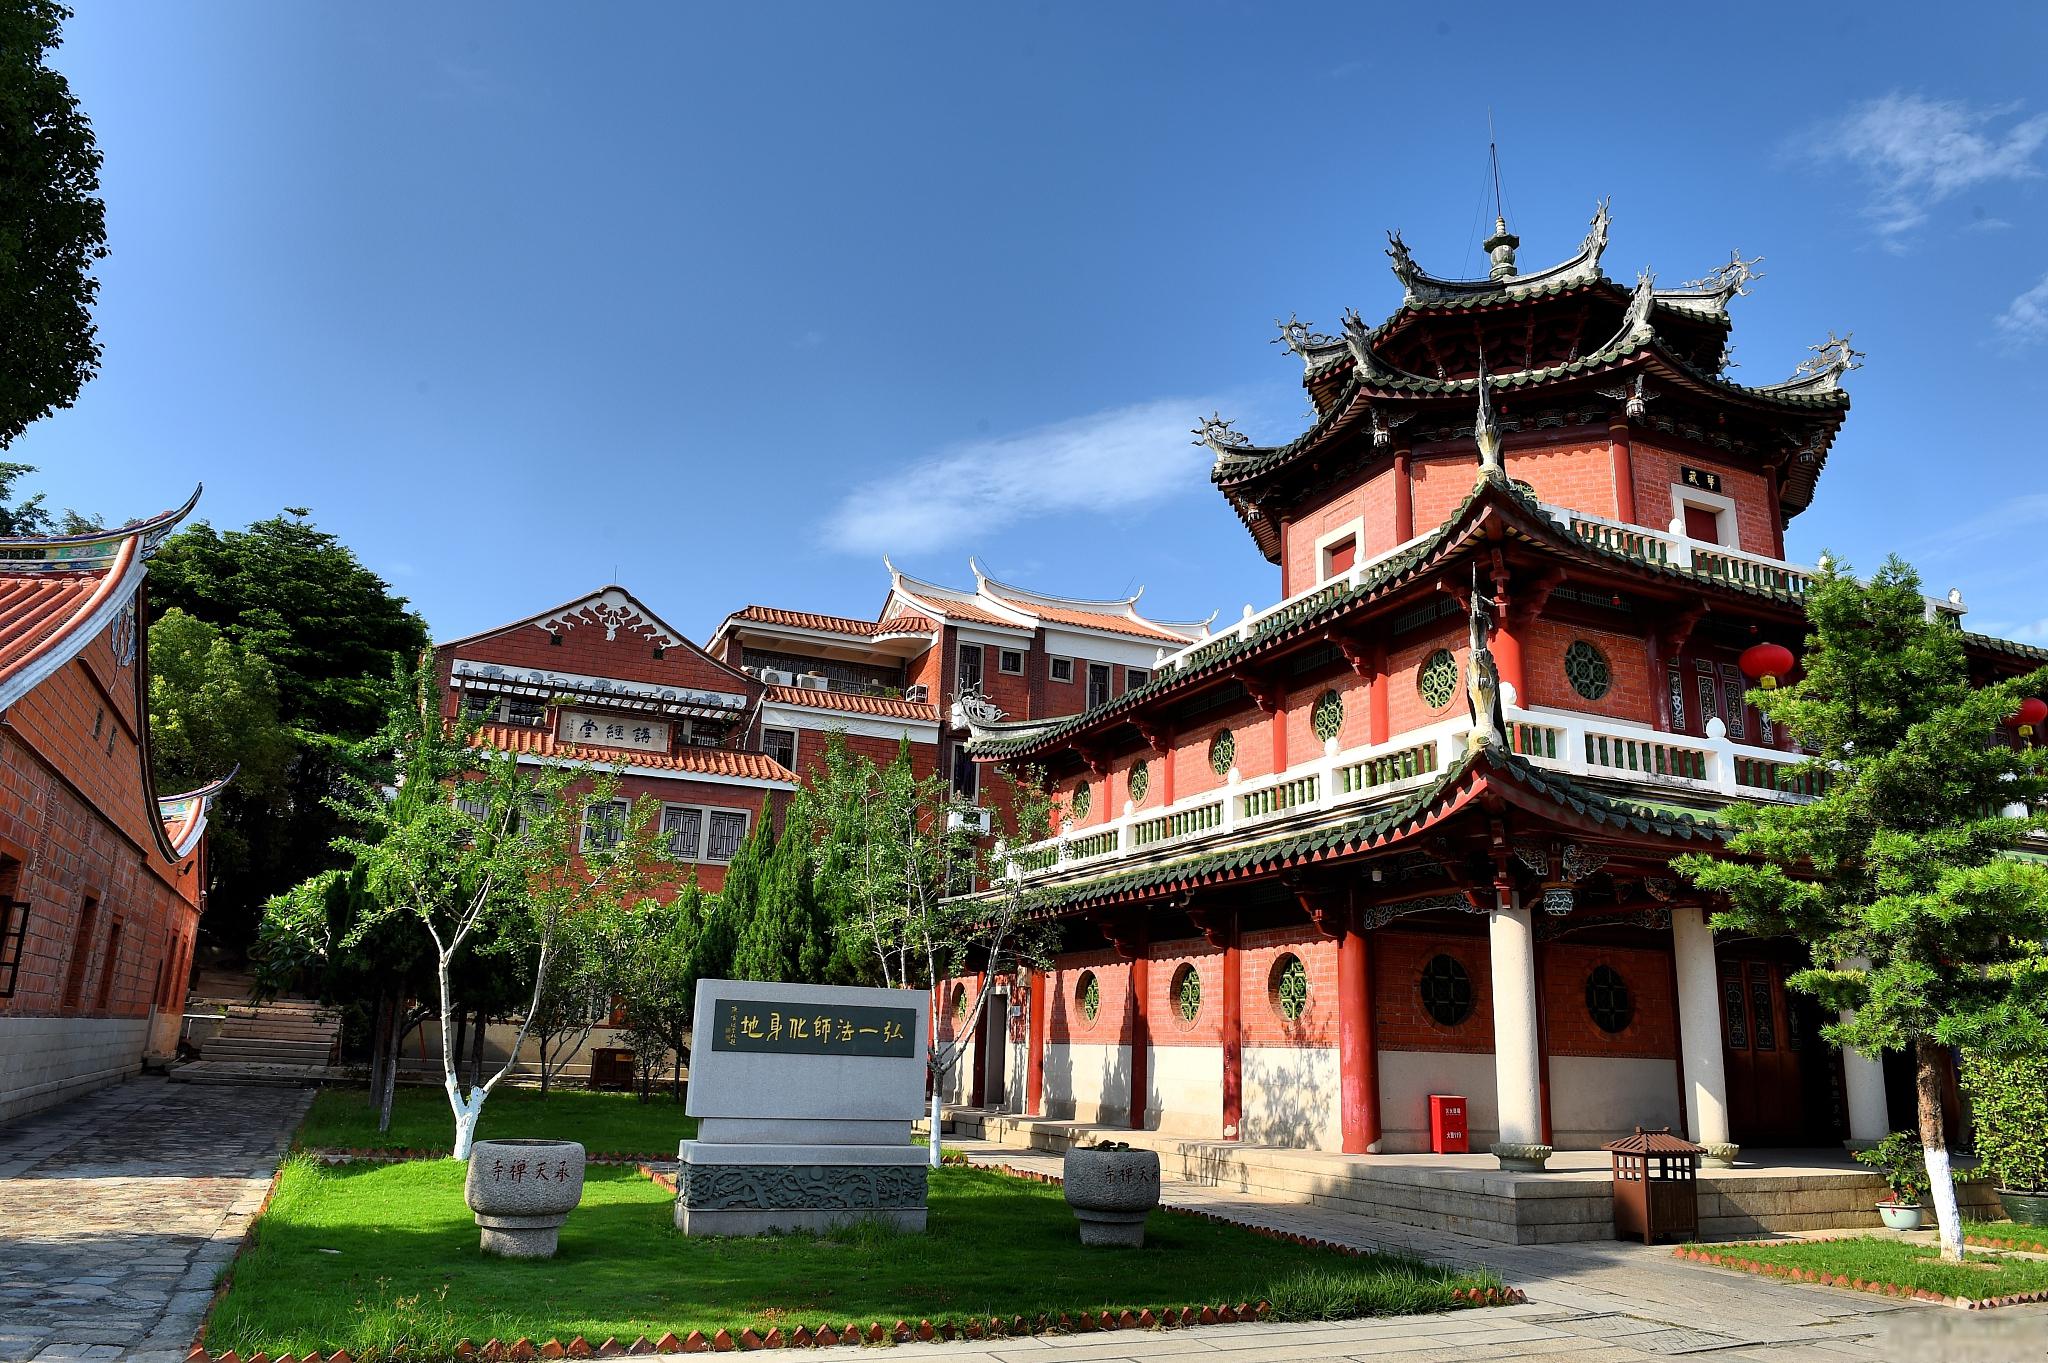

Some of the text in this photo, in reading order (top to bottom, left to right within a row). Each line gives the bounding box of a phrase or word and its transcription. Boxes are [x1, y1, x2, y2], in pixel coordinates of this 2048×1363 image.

[579, 718, 652, 744] 講經堂
[740, 1012, 904, 1044] 弘一法師化身地
[493, 1159, 571, 1184] 承天禪寺
